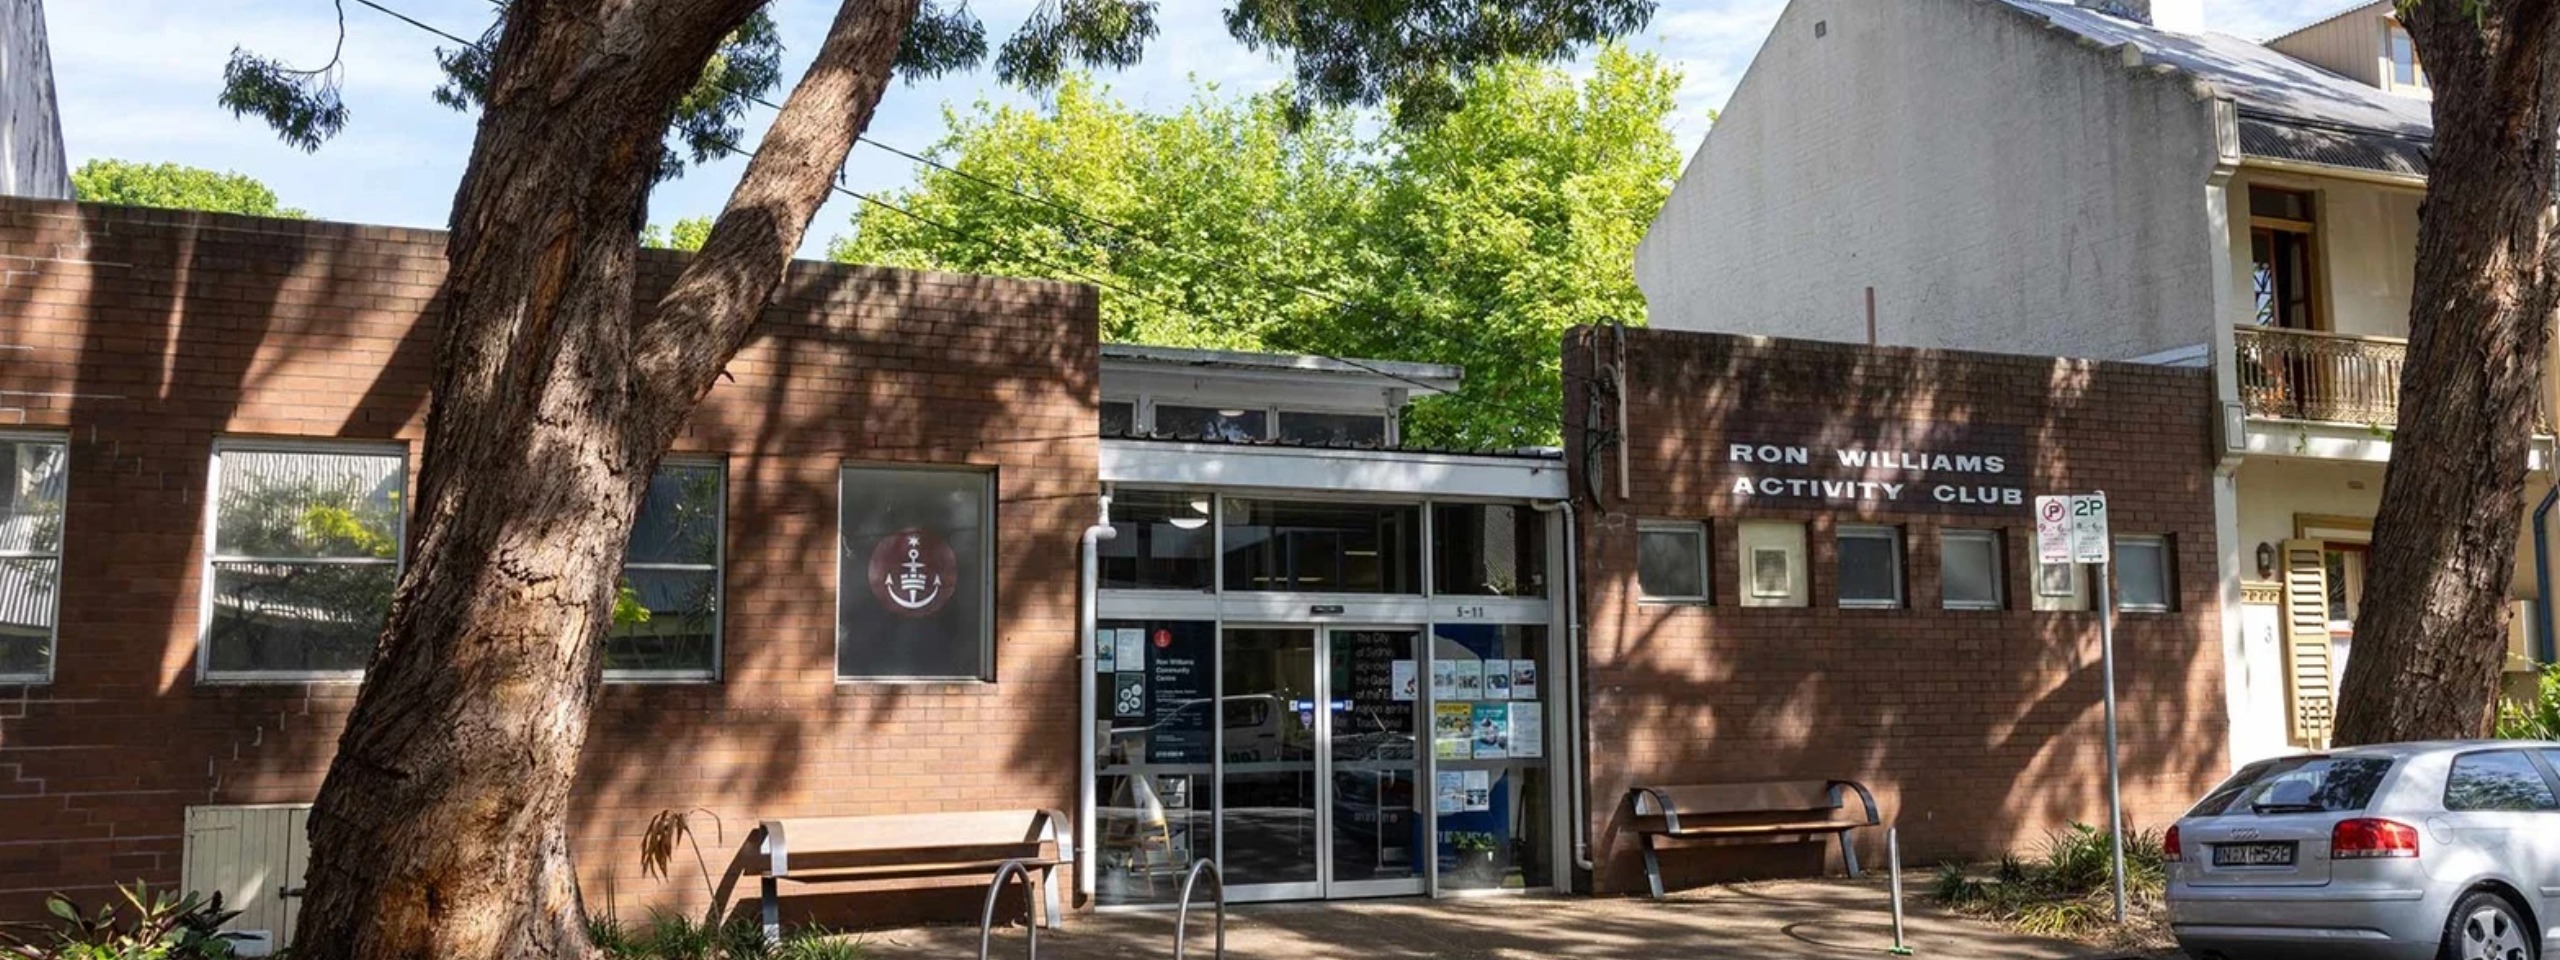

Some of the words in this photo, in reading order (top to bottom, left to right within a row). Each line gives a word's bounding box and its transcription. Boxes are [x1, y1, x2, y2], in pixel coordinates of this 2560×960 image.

[1729, 443, 1808, 464] RON
[1836, 449, 2006, 474] WILLIAMS
[1731, 477, 1905, 500] ACTIVITY
[1933, 485, 2024, 505] CLUB
[2074, 500, 2103, 516] 2P
[1456, 606, 1484, 618] 5-11
[1372, 632, 1389, 644] City
[1155, 667, 1190, 675] Community
